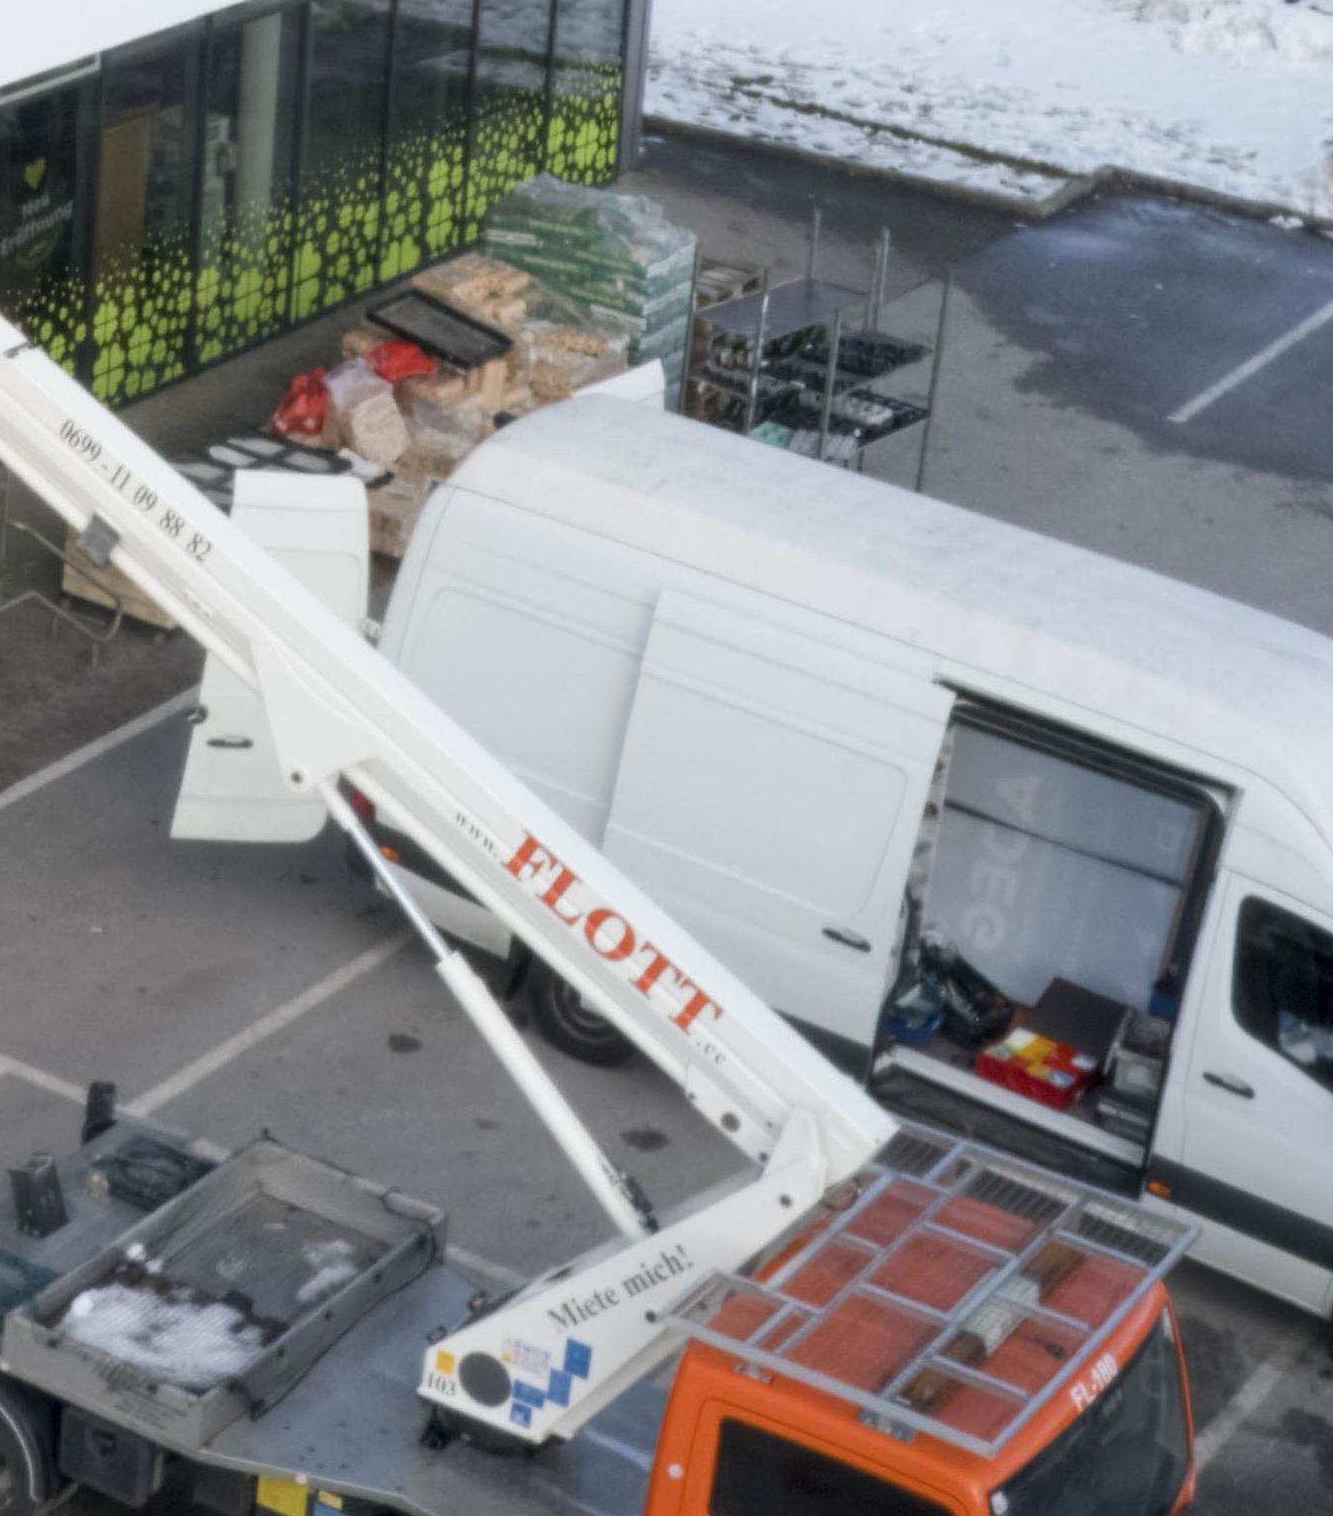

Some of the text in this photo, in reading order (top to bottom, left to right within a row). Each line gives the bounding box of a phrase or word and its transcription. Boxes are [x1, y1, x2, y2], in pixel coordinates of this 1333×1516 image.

[59, 419, 103, 462] 0699
[133, 485, 159, 512] 09
[159, 508, 186, 540] 88
[186, 532, 213, 563] 82
[546, 1244, 694, 1334] Miete mich!
[427, 1374, 458, 1397] 103
